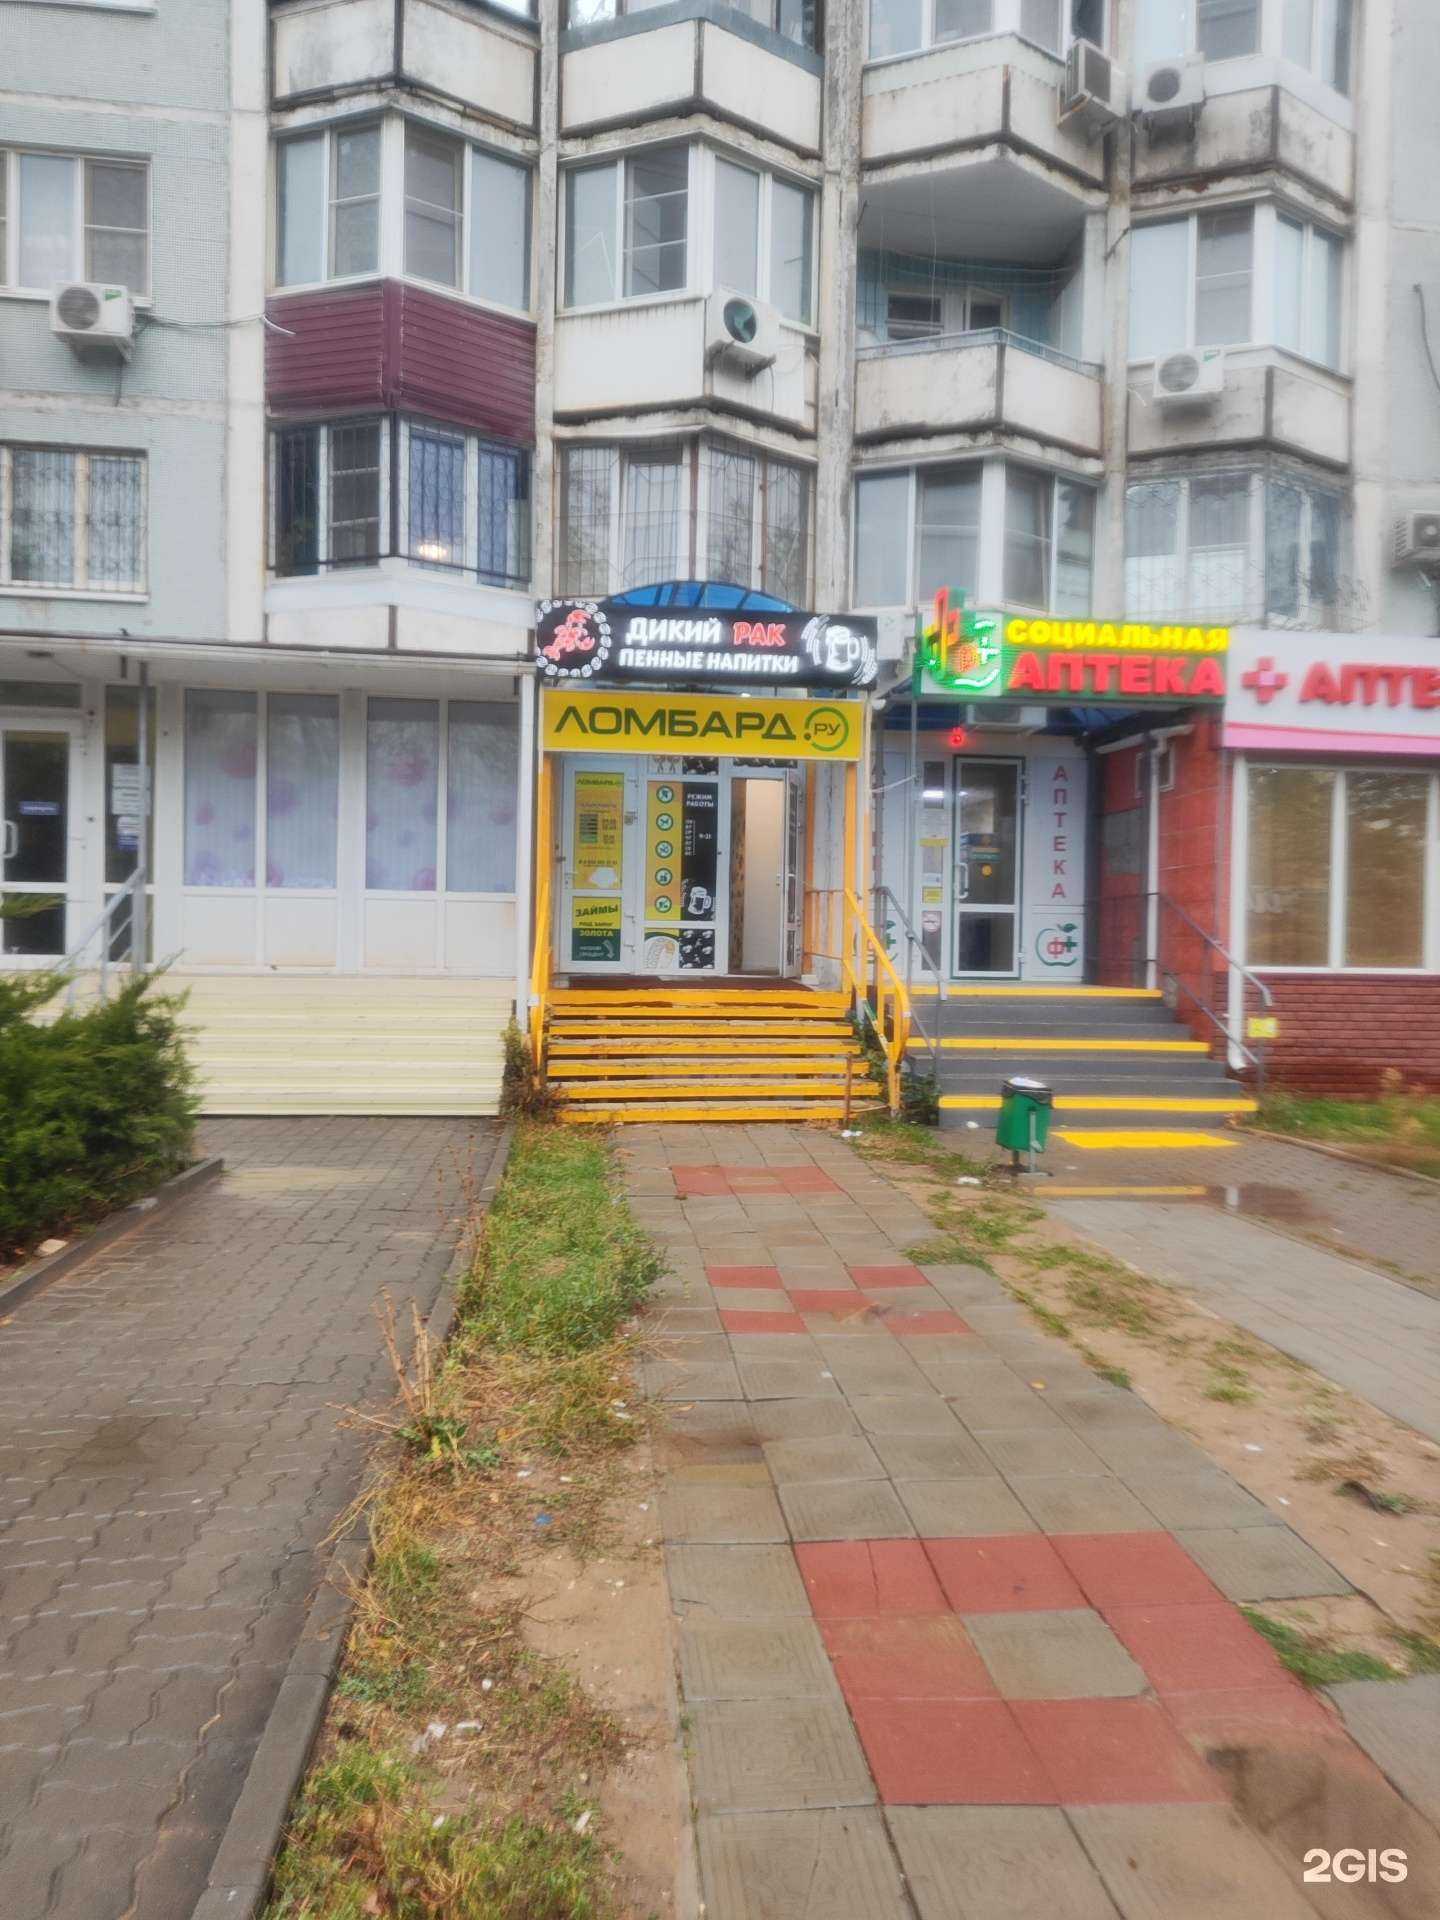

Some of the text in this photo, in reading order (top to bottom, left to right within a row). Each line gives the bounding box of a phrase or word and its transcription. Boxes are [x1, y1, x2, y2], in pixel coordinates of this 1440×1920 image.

[625, 616, 786, 647] ДИКИЙ РАК
[1006, 618, 1230, 652] СОЦИАЛЬНАЯ
[618, 648, 799, 673] ПЕННЫЕ НАПИТКИ
[1007, 652, 1226, 697] АПТЕКА
[686, 800, 714, 808] РАБОТЫ
[1051, 765, 1070, 899] АПТЕКА
[575, 904, 618, 917] ЗАЙМЫ
[579, 929, 614, 937] ЗОЛОТА
